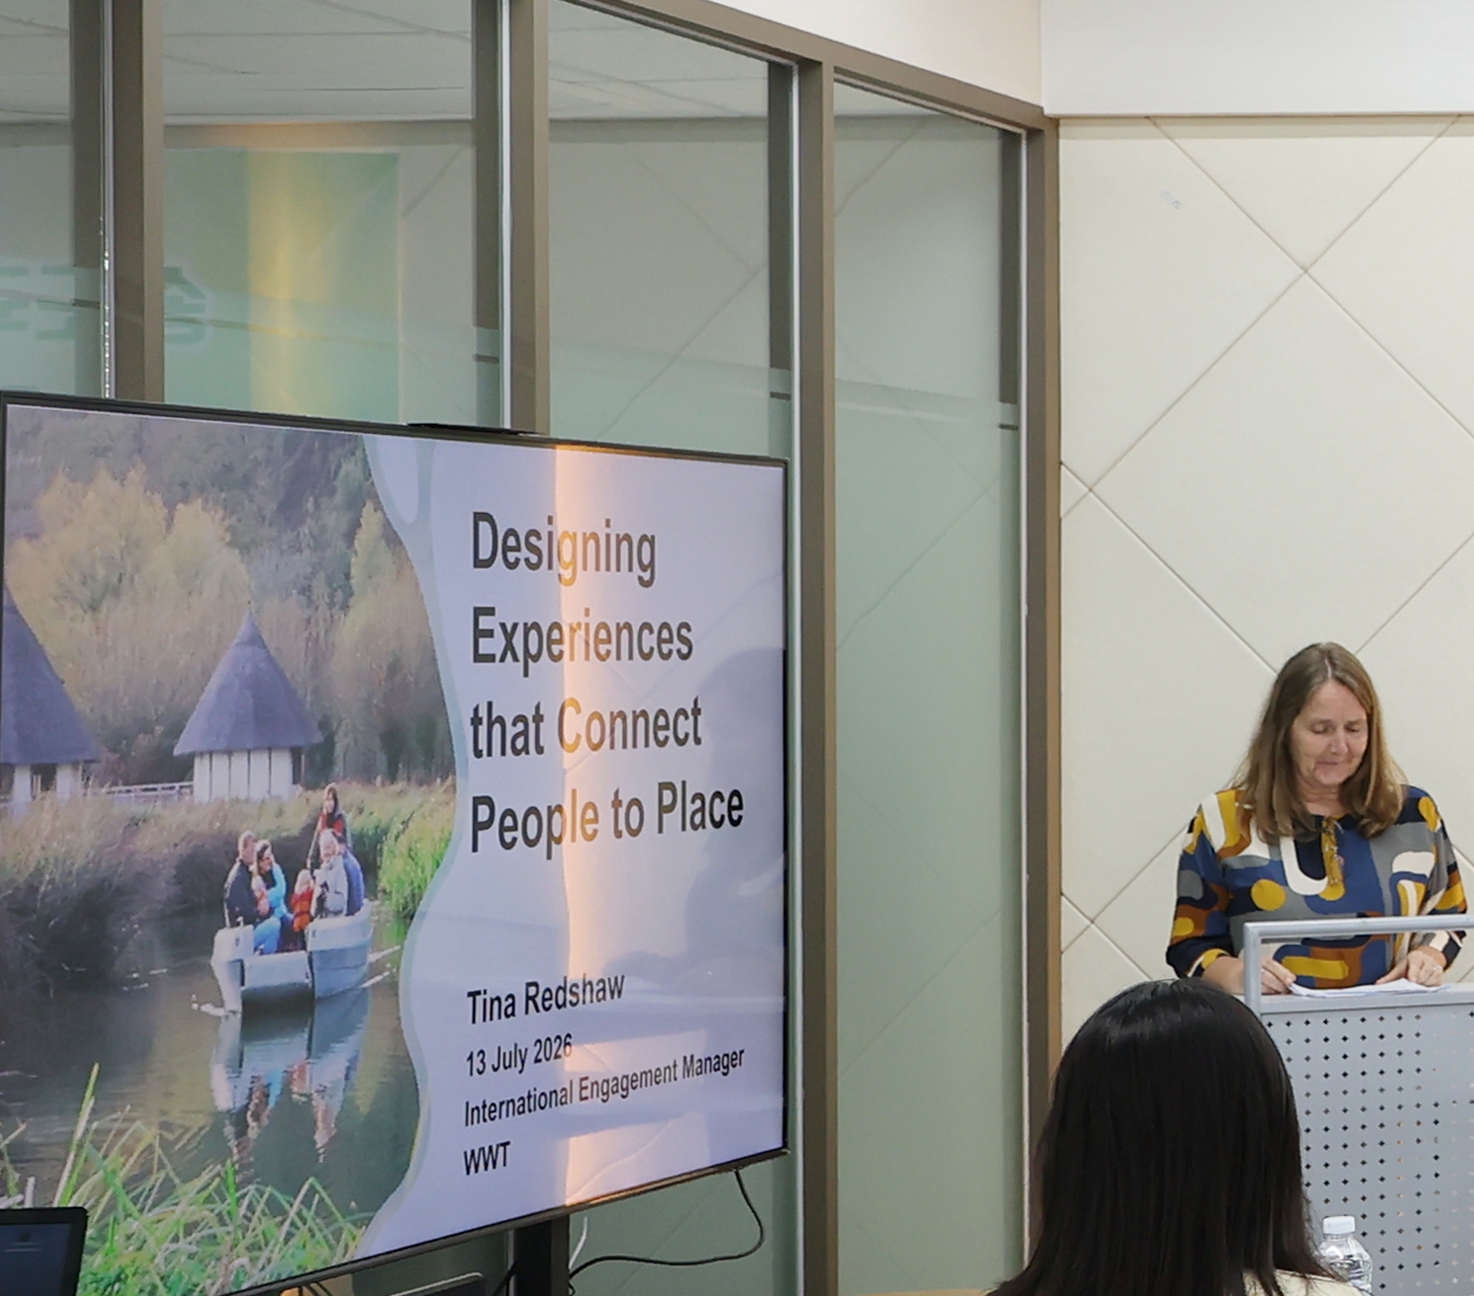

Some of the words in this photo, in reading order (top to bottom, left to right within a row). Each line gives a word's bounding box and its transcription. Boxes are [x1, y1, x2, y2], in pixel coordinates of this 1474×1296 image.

[473, 511, 656, 588] Designing
[473, 606, 693, 677] Experiences
[470, 701, 544, 759] that
[558, 695, 702, 753] Connect
[472, 788, 600, 860] People
[611, 787, 645, 839] to
[657, 780, 744, 834] Place
[467, 989, 516, 1025] Tina
[524, 974, 626, 1016] Redshaw
[464, 1079, 574, 1127] International
[579, 1059, 678, 1103] Engagement
[682, 1049, 745, 1078] Manager
[466, 1049, 487, 1077] 13
[491, 1042, 528, 1074] July
[533, 1032, 573, 1065] 2026
[463, 1141, 511, 1176] WWT
